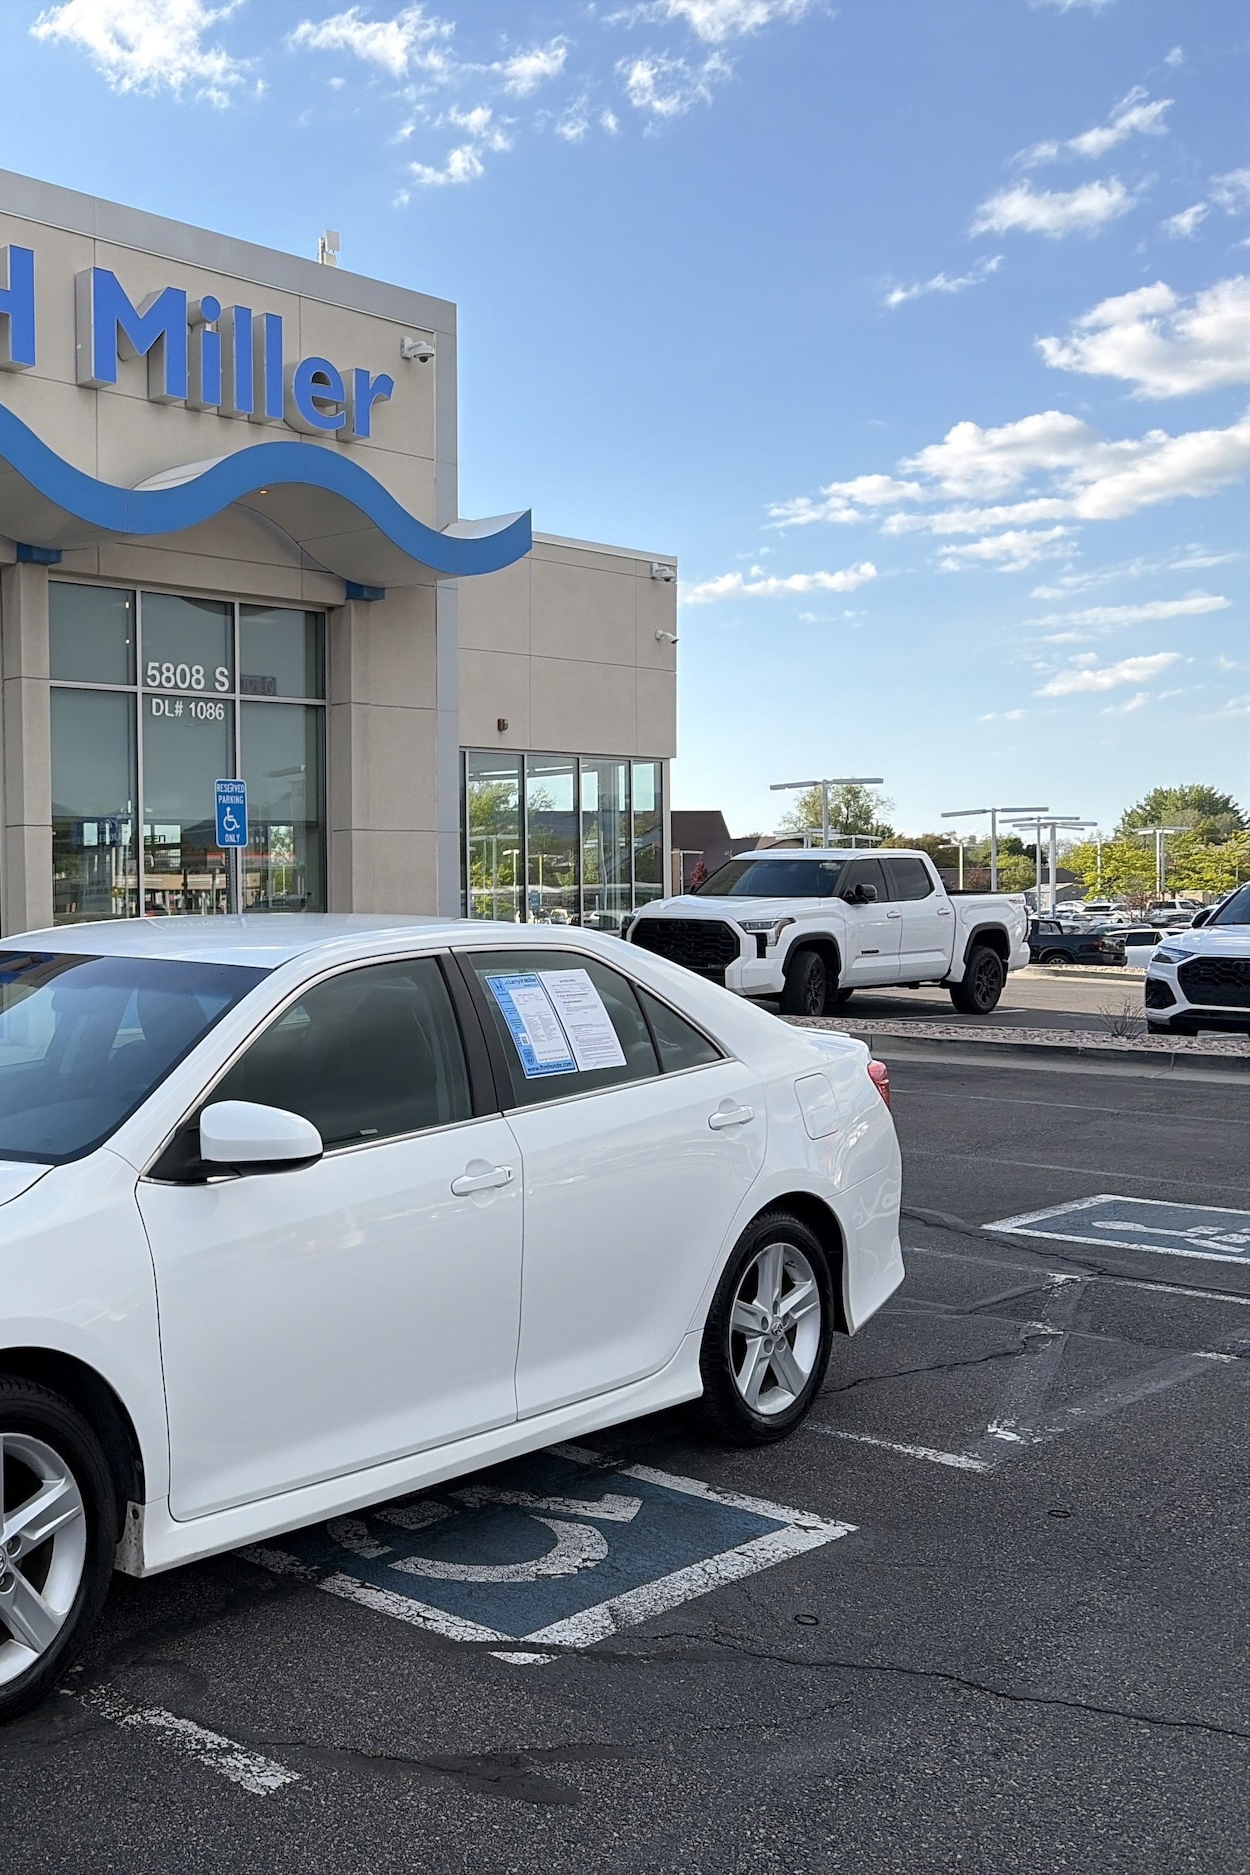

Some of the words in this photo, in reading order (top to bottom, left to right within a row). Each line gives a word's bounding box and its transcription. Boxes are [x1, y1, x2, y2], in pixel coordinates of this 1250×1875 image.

[76, 266, 394, 442] Miller
[146, 662, 205, 690] 5808
[214, 666, 230, 691] S
[152, 698, 183, 717] DL#
[189, 702, 225, 720] 1086
[216, 784, 245, 793] RESERVED
[218, 795, 244, 804] PARKING
[224, 833, 241, 843] ONLY
